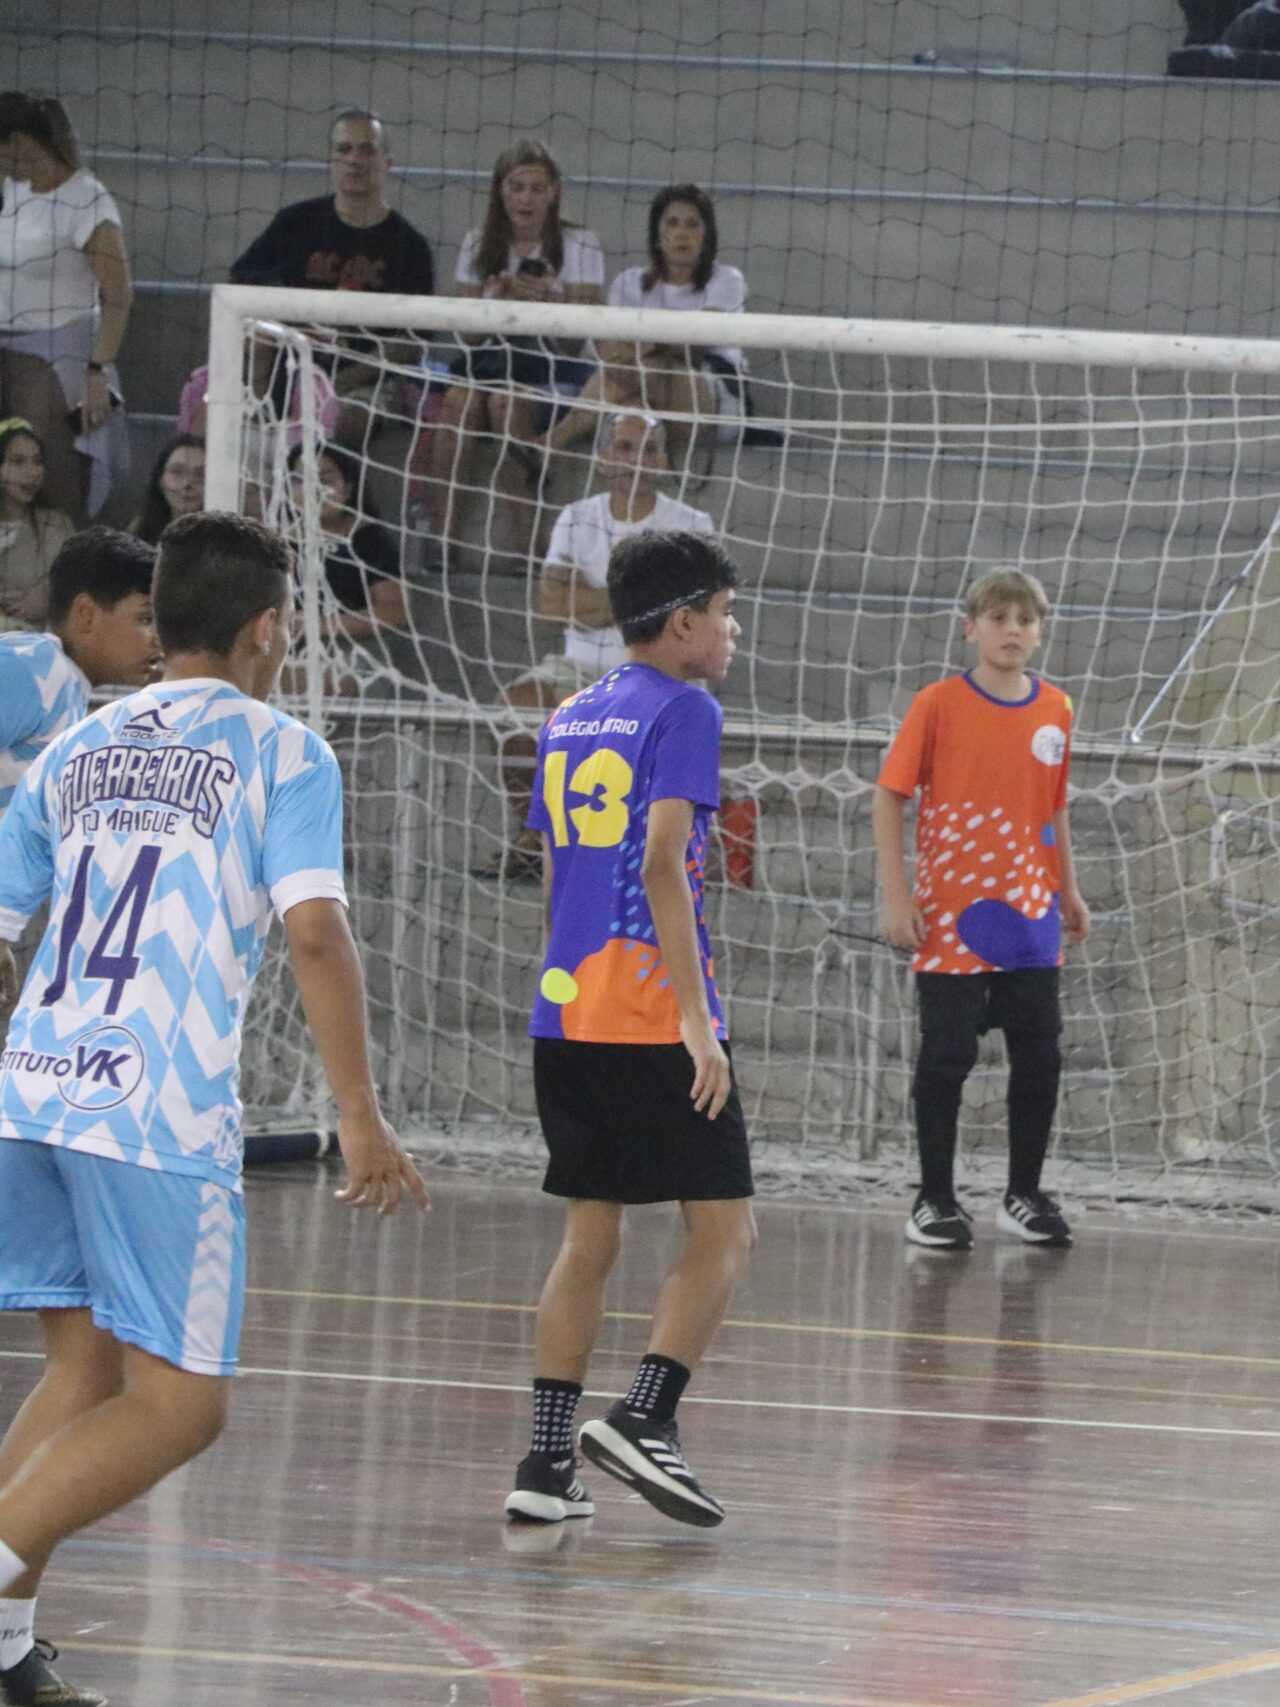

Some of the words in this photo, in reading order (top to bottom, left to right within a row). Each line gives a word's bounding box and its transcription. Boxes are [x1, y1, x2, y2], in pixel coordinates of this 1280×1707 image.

[547, 718, 600, 740] COLÉGIO
[58, 744, 237, 841] GUERREIROS
[543, 748, 633, 847] 13
[40, 844, 163, 1016] 14
[75, 1044, 133, 1089] VK
